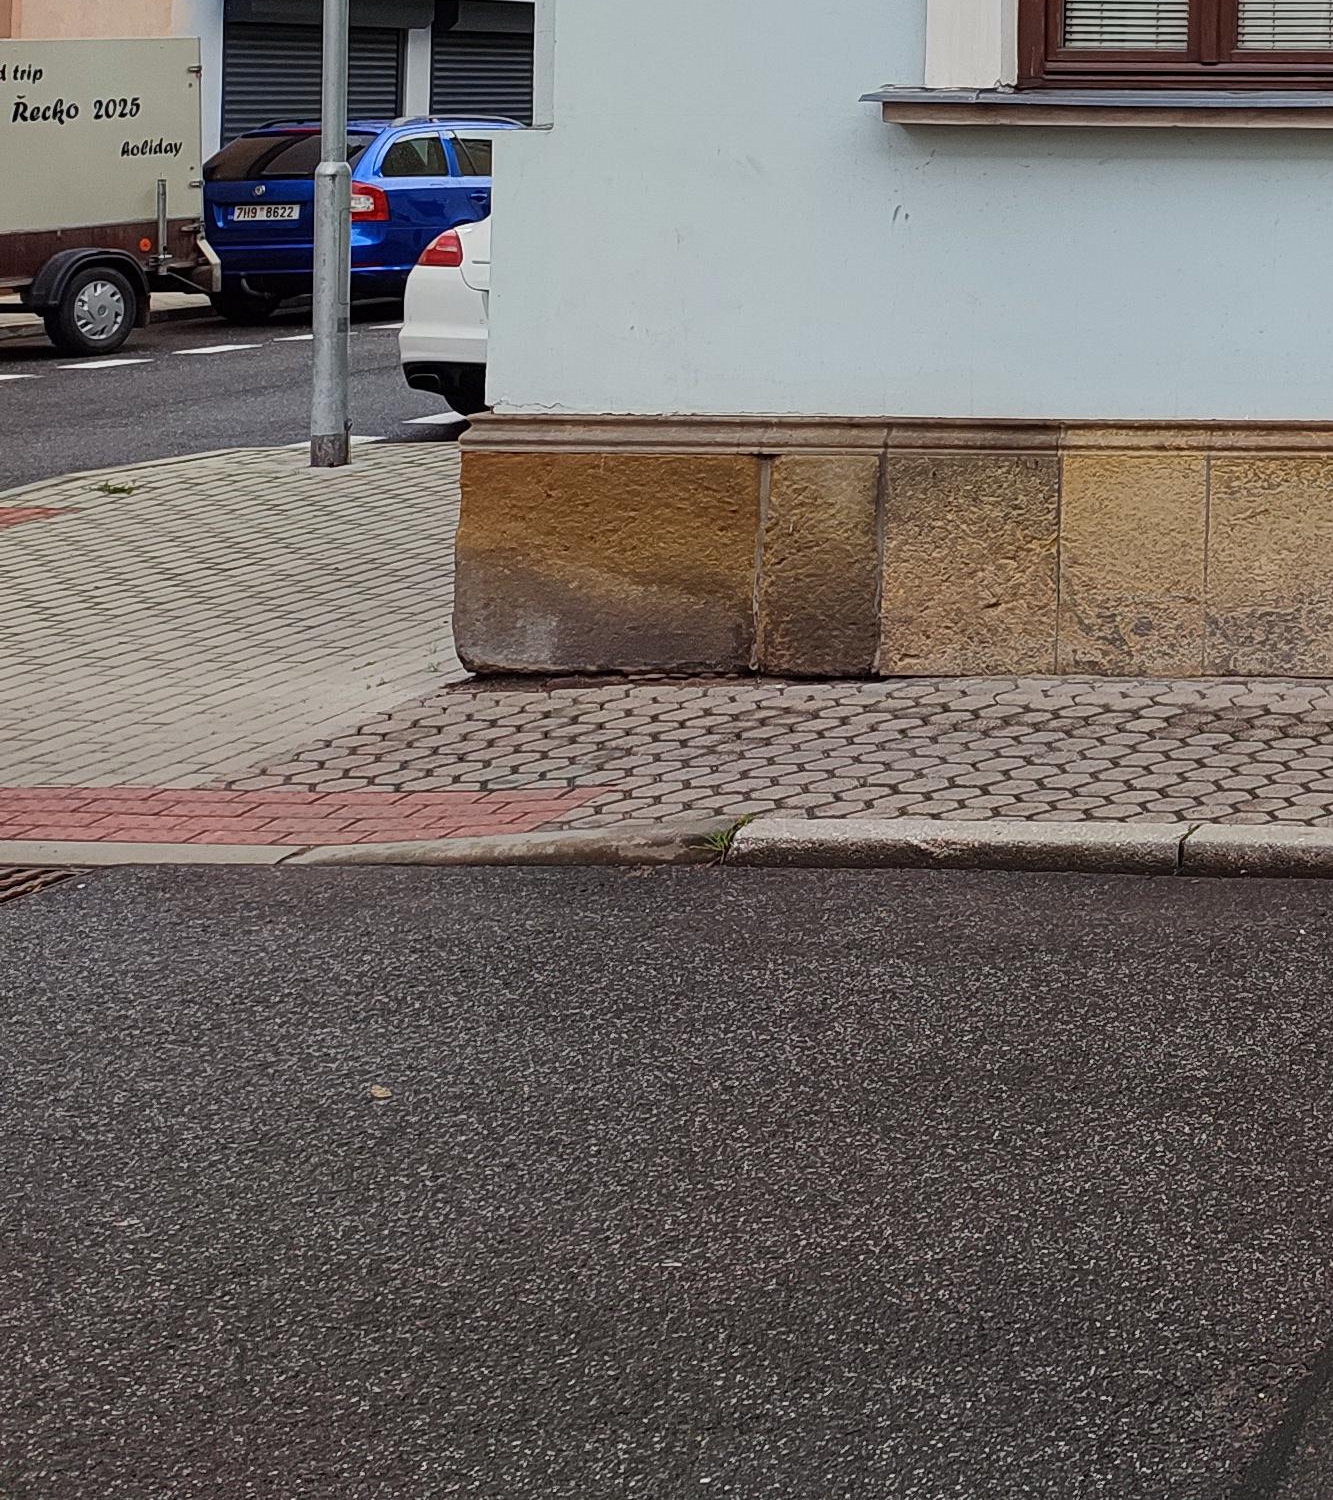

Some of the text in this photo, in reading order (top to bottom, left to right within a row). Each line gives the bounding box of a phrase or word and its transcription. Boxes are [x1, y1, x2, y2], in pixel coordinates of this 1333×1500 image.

[13, 63, 43, 84] trip
[12, 95, 141, 125] Řecko 2025
[121, 137, 183, 158] holiday
[265, 206, 294, 218] 8622
